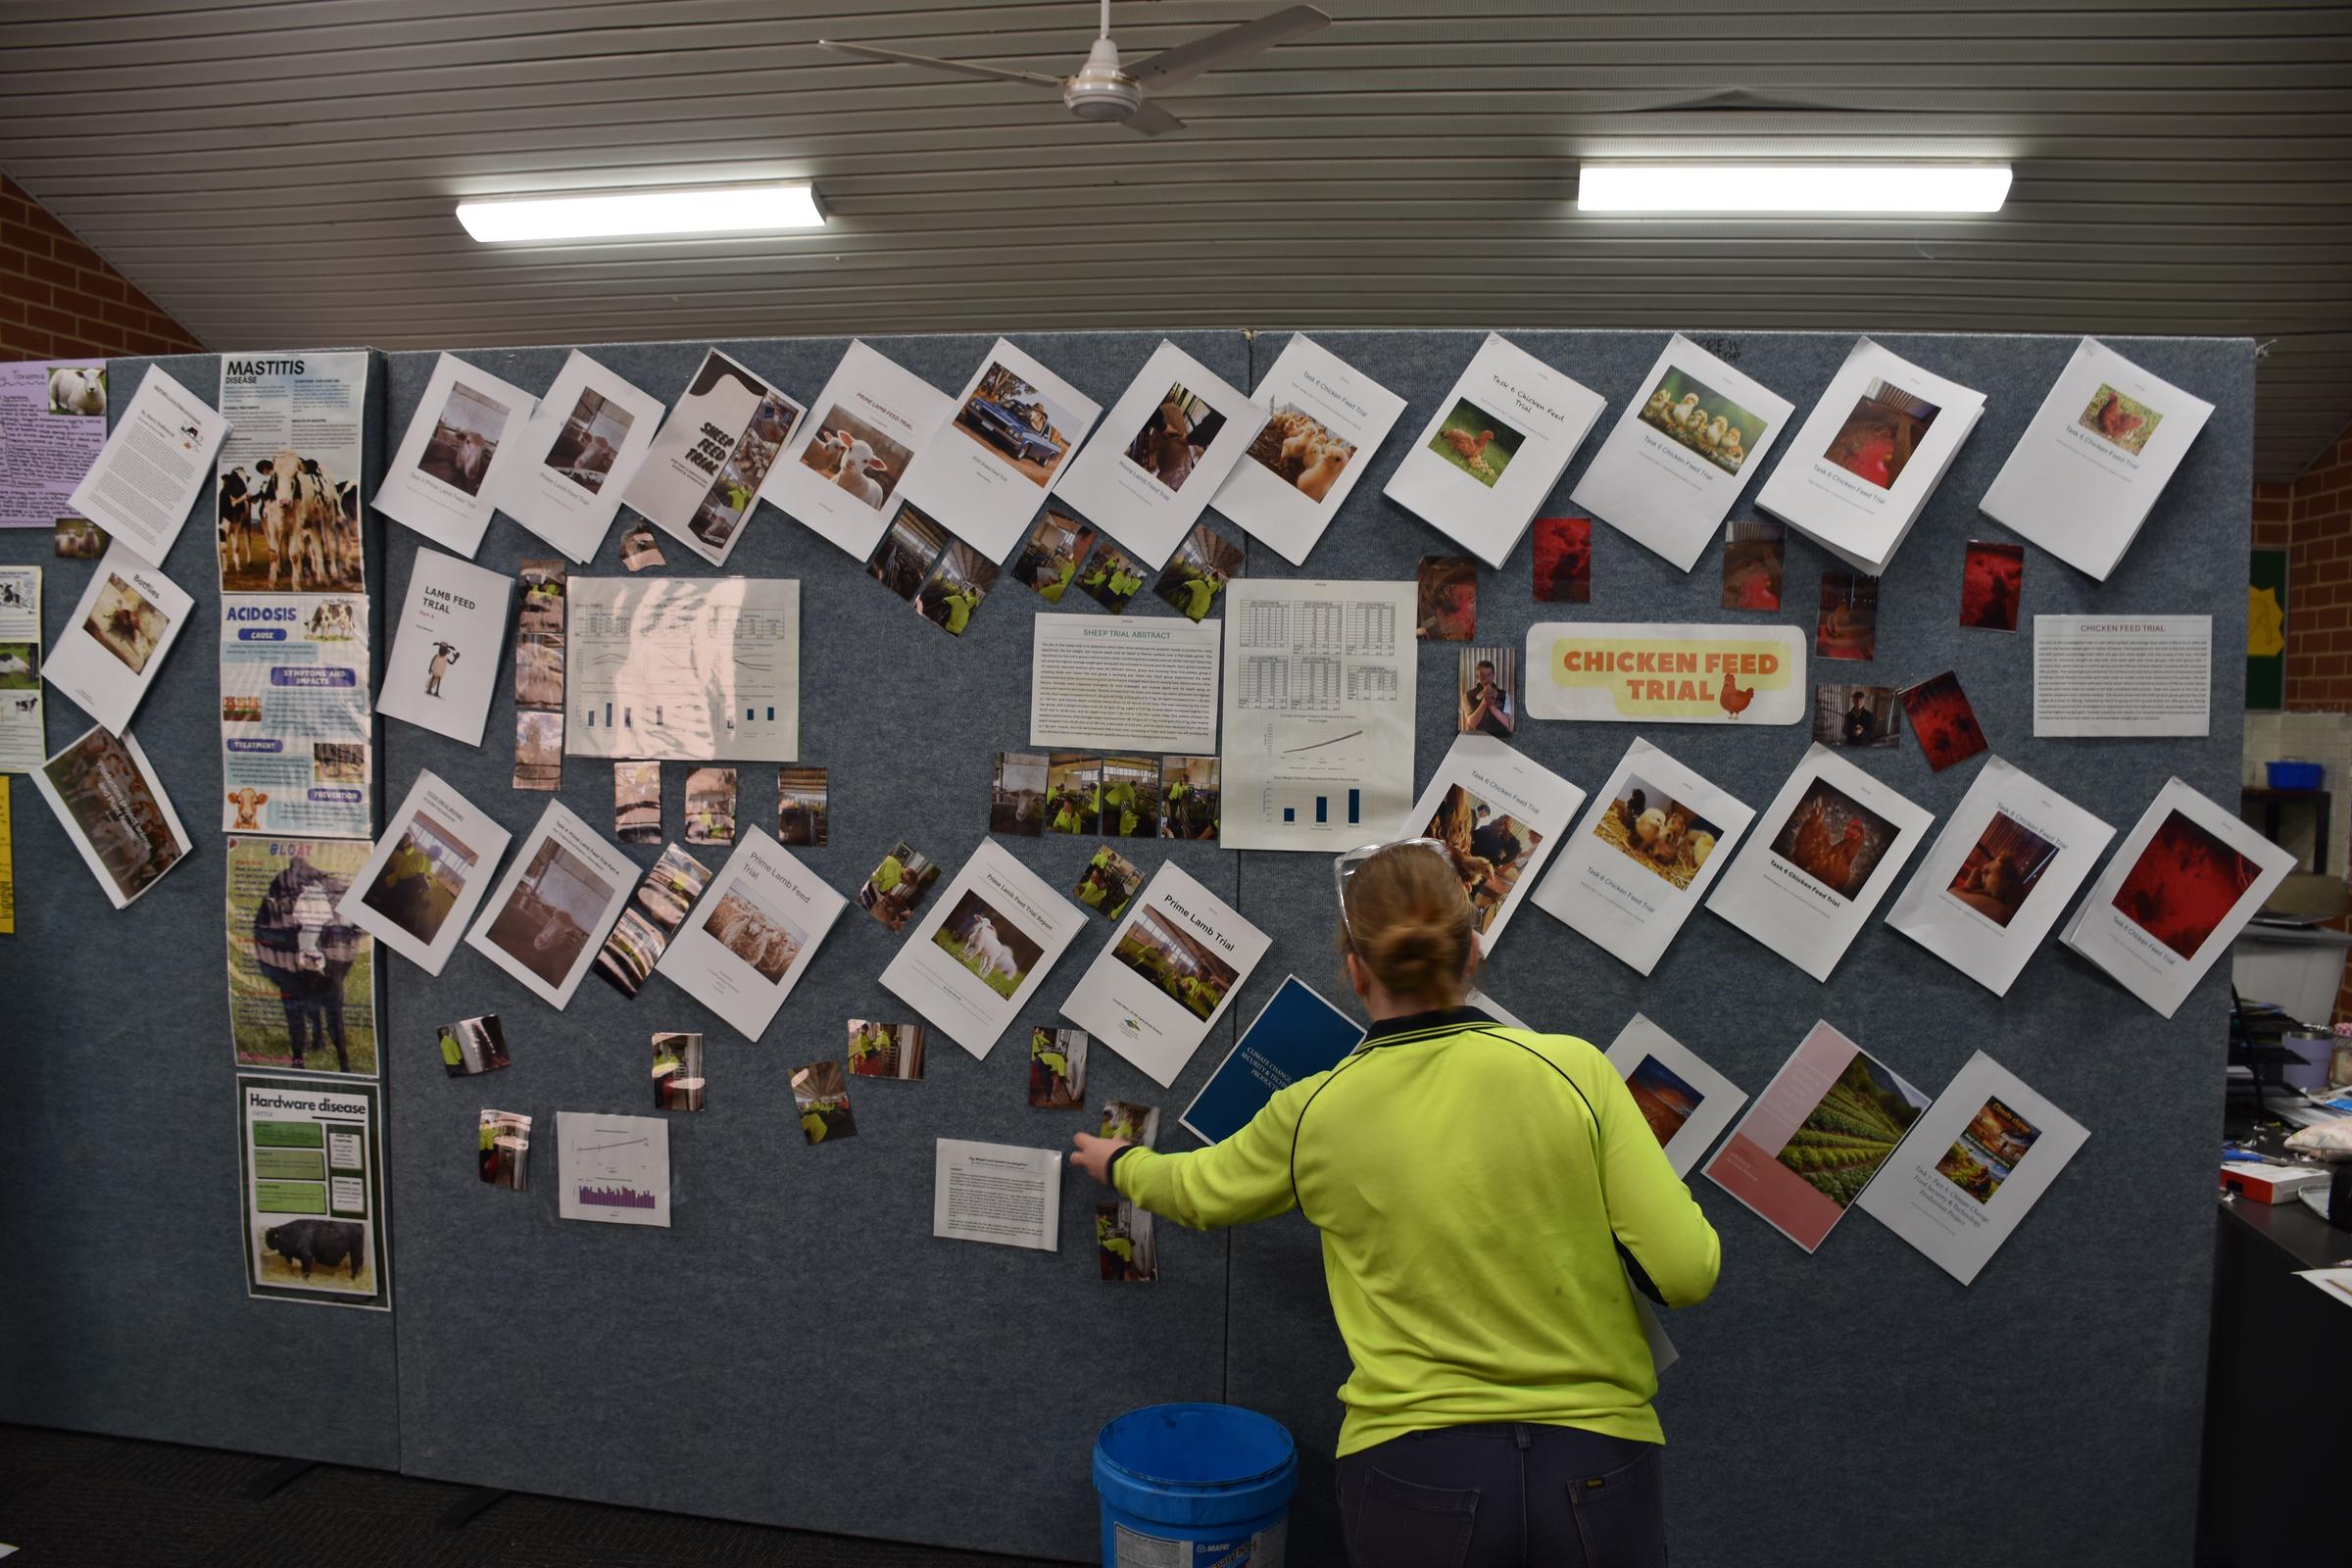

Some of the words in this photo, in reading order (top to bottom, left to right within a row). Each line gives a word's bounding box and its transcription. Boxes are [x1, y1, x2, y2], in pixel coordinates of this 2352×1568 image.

[227, 361, 305, 375] MASTITIS
[1319, 382, 1343, 400] Chicken
[1491, 374, 1509, 388] Task
[1516, 389, 1545, 411] Chicken
[1545, 407, 1564, 421] Feed
[856, 391, 873, 405] PRIME
[870, 401, 887, 414] LAMB
[885, 410, 900, 421] FEED
[898, 417, 913, 430] TRIAL
[1513, 398, 1532, 413] Trial
[698, 419, 737, 450] SHEEP
[683, 446, 720, 476] TRIAL
[696, 435, 729, 463] FEED
[422, 598, 451, 613] TRIAL
[425, 586, 451, 601] LAMB
[453, 596, 475, 610] FEED
[226, 607, 297, 621] ACIDOSIS
[1110, 629, 1130, 638] TRIAL
[1132, 630, 1171, 640] ABSTRACT
[1563, 651, 1697, 673] CHICKEN
[1704, 653, 1779, 674] FEED
[1626, 679, 1715, 701] TRIAL
[1471, 769, 1485, 781] Task
[1489, 780, 1512, 798] Chicken
[1511, 794, 1527, 807] Feed
[1527, 804, 1540, 814] Trial
[2014, 813, 2039, 831] Chicken
[2038, 827, 2055, 841] Feed
[270, 843, 314, 858] BLOAT
[741, 862, 760, 879] Trial
[749, 851, 773, 872] Prime
[769, 868, 793, 889] Lamb
[790, 884, 811, 904] Feed
[1587, 865, 1600, 878] Task
[1603, 877, 1628, 896] Chicken
[1626, 892, 1642, 906] Feed
[1642, 902, 1655, 913] Trial
[1769, 859, 1784, 871] Task
[1787, 870, 1813, 890] Chicken
[1811, 886, 1827, 899] Feed
[1826, 896, 1840, 907] Trial
[986, 873, 1002, 887] Prime
[1000, 885, 1014, 898] Lamb
[1012, 896, 1026, 907] Feed
[1024, 906, 1038, 917] Trial
[1035, 915, 1054, 931] Report
[1163, 894, 1191, 917] Prime
[1188, 912, 1215, 937] Lamb
[1212, 932, 1235, 952] Trial
[1240, 1050, 1266, 1073] SECURITY
[1246, 1045, 1270, 1066] CLIMATE
[250, 1093, 316, 1110] Hardware
[318, 1098, 367, 1114] disease
[1918, 1188, 1947, 1212] Production
[1945, 1208, 1966, 1227] Project
[1925, 1184, 1947, 1202] Security
[1951, 1203, 1983, 1229] Technology
[1207, 1544, 1231, 1552] MAPEI
